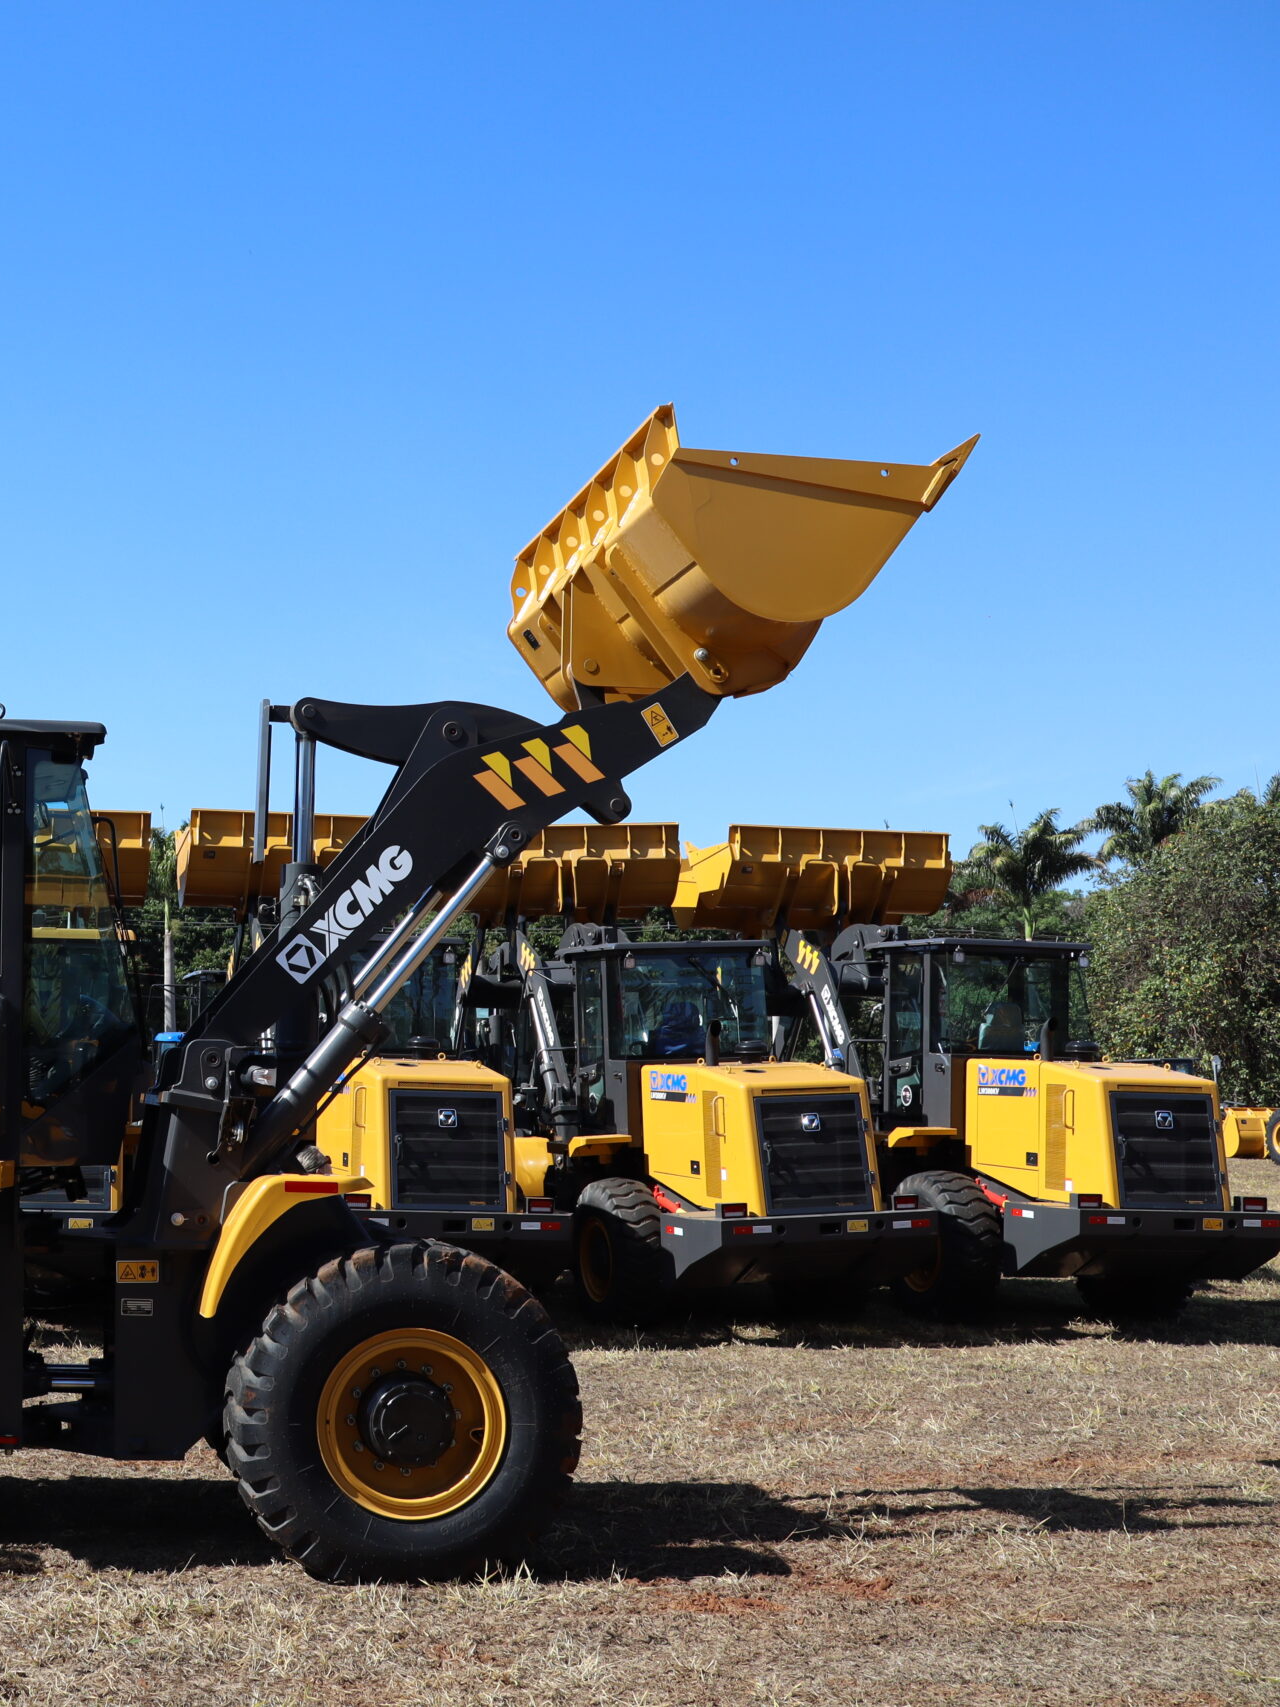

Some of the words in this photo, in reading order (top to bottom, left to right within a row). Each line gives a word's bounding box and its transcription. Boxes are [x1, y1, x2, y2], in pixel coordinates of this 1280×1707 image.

[309, 845, 413, 958] XCMG
[659, 1073, 688, 1092] XCMG
[991, 1068, 1027, 1087] XCMG
